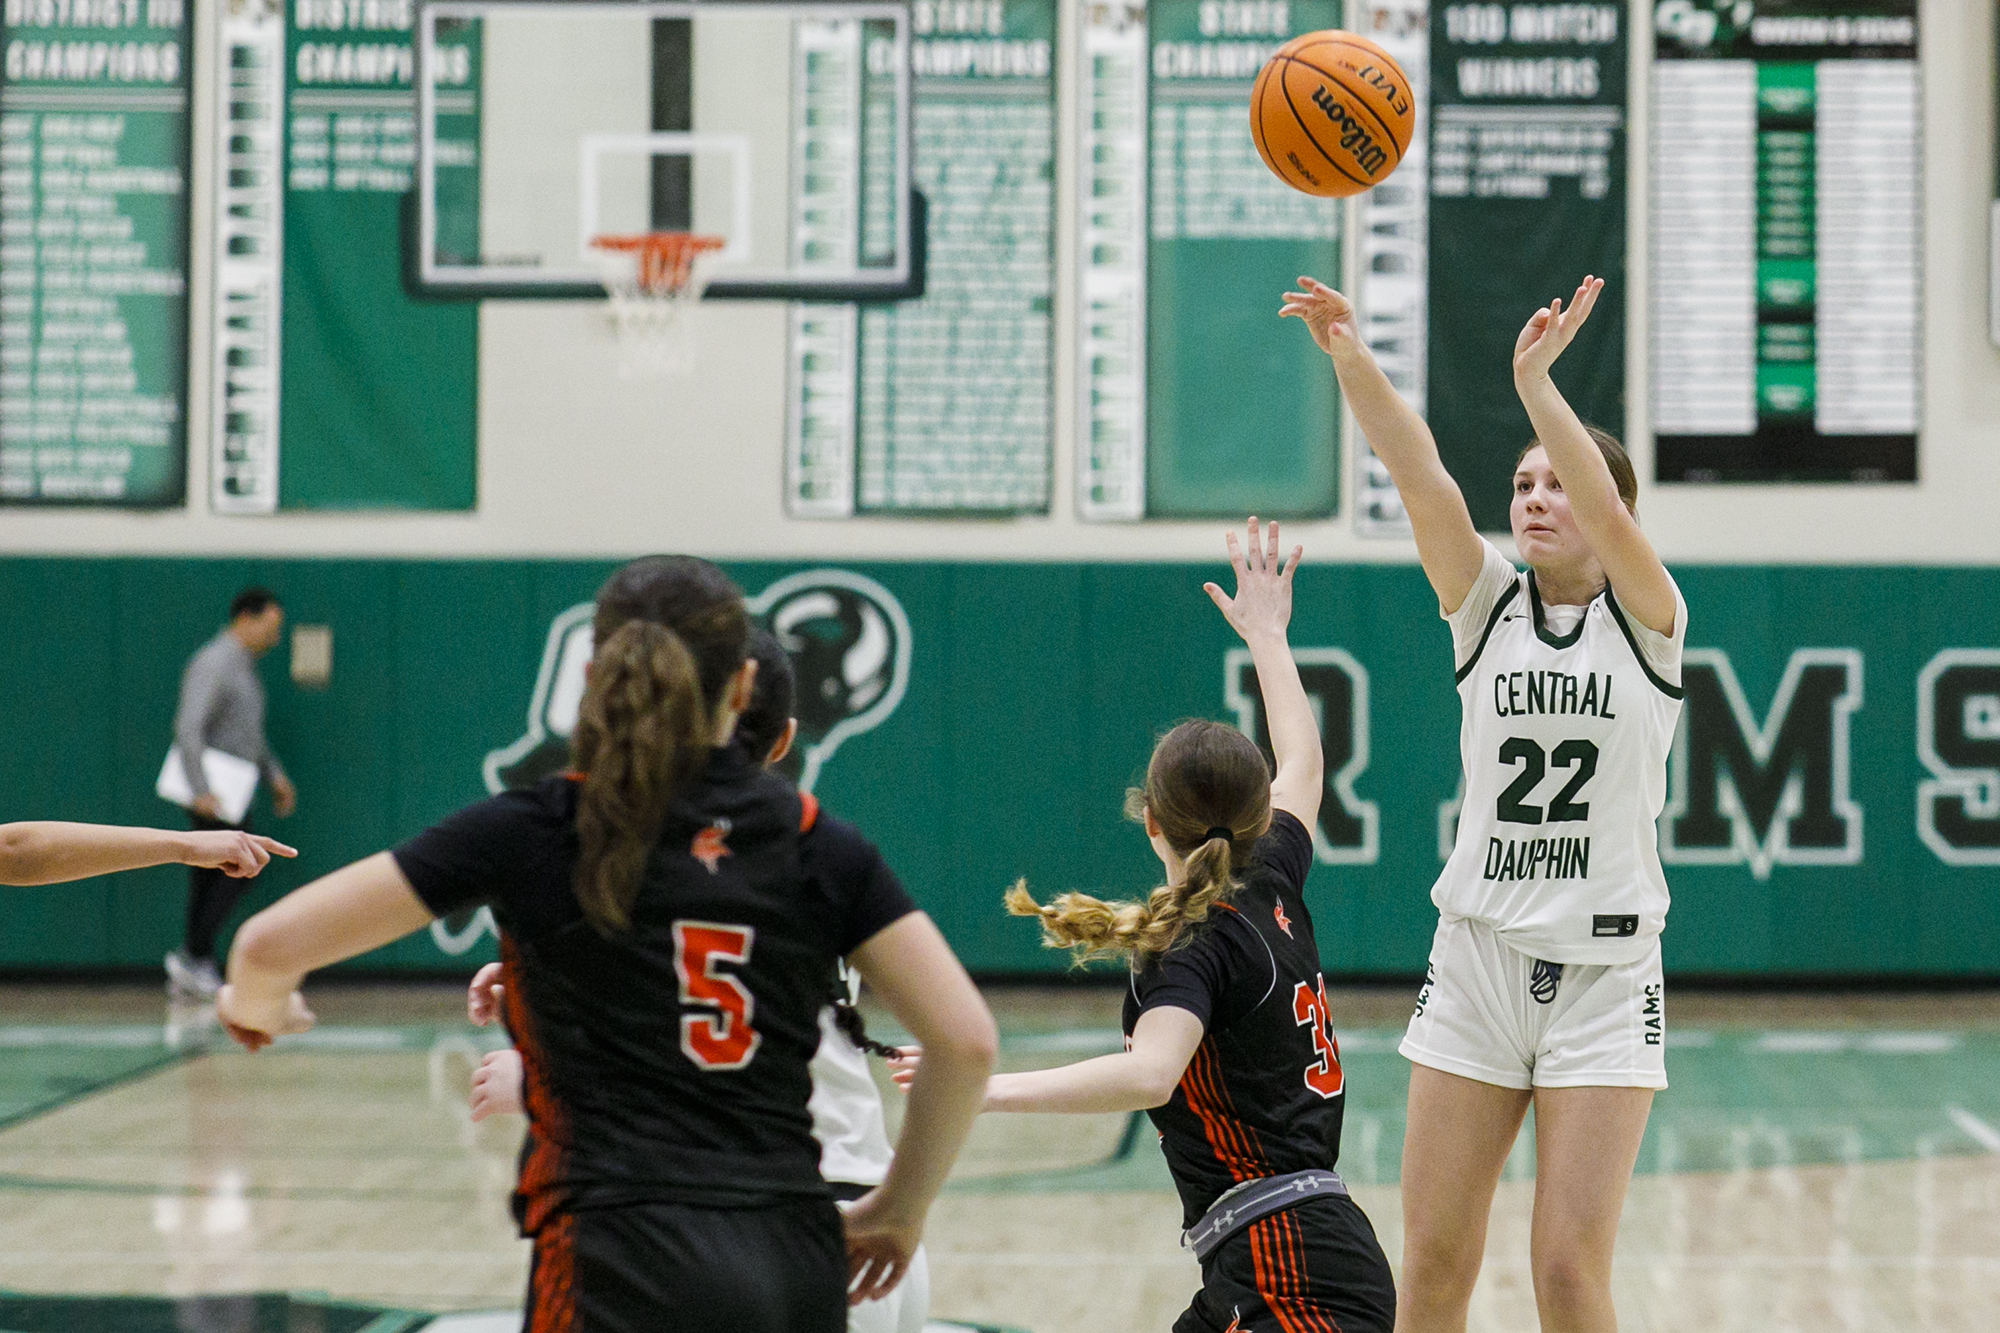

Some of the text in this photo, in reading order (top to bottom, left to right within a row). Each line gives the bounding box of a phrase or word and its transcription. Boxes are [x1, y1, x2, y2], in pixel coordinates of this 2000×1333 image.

[5, 40, 180, 82] CHAMPIONS
[1311, 83, 1387, 177] Wilson
[1494, 670, 1616, 720] CENTRAL
[1496, 736, 1600, 825] 22
[1483, 836, 1590, 882] DAUPHIN
[1625, 921, 1633, 931] S
[672, 919, 762, 1071] 5
[1642, 984, 1662, 1045] RAMS
